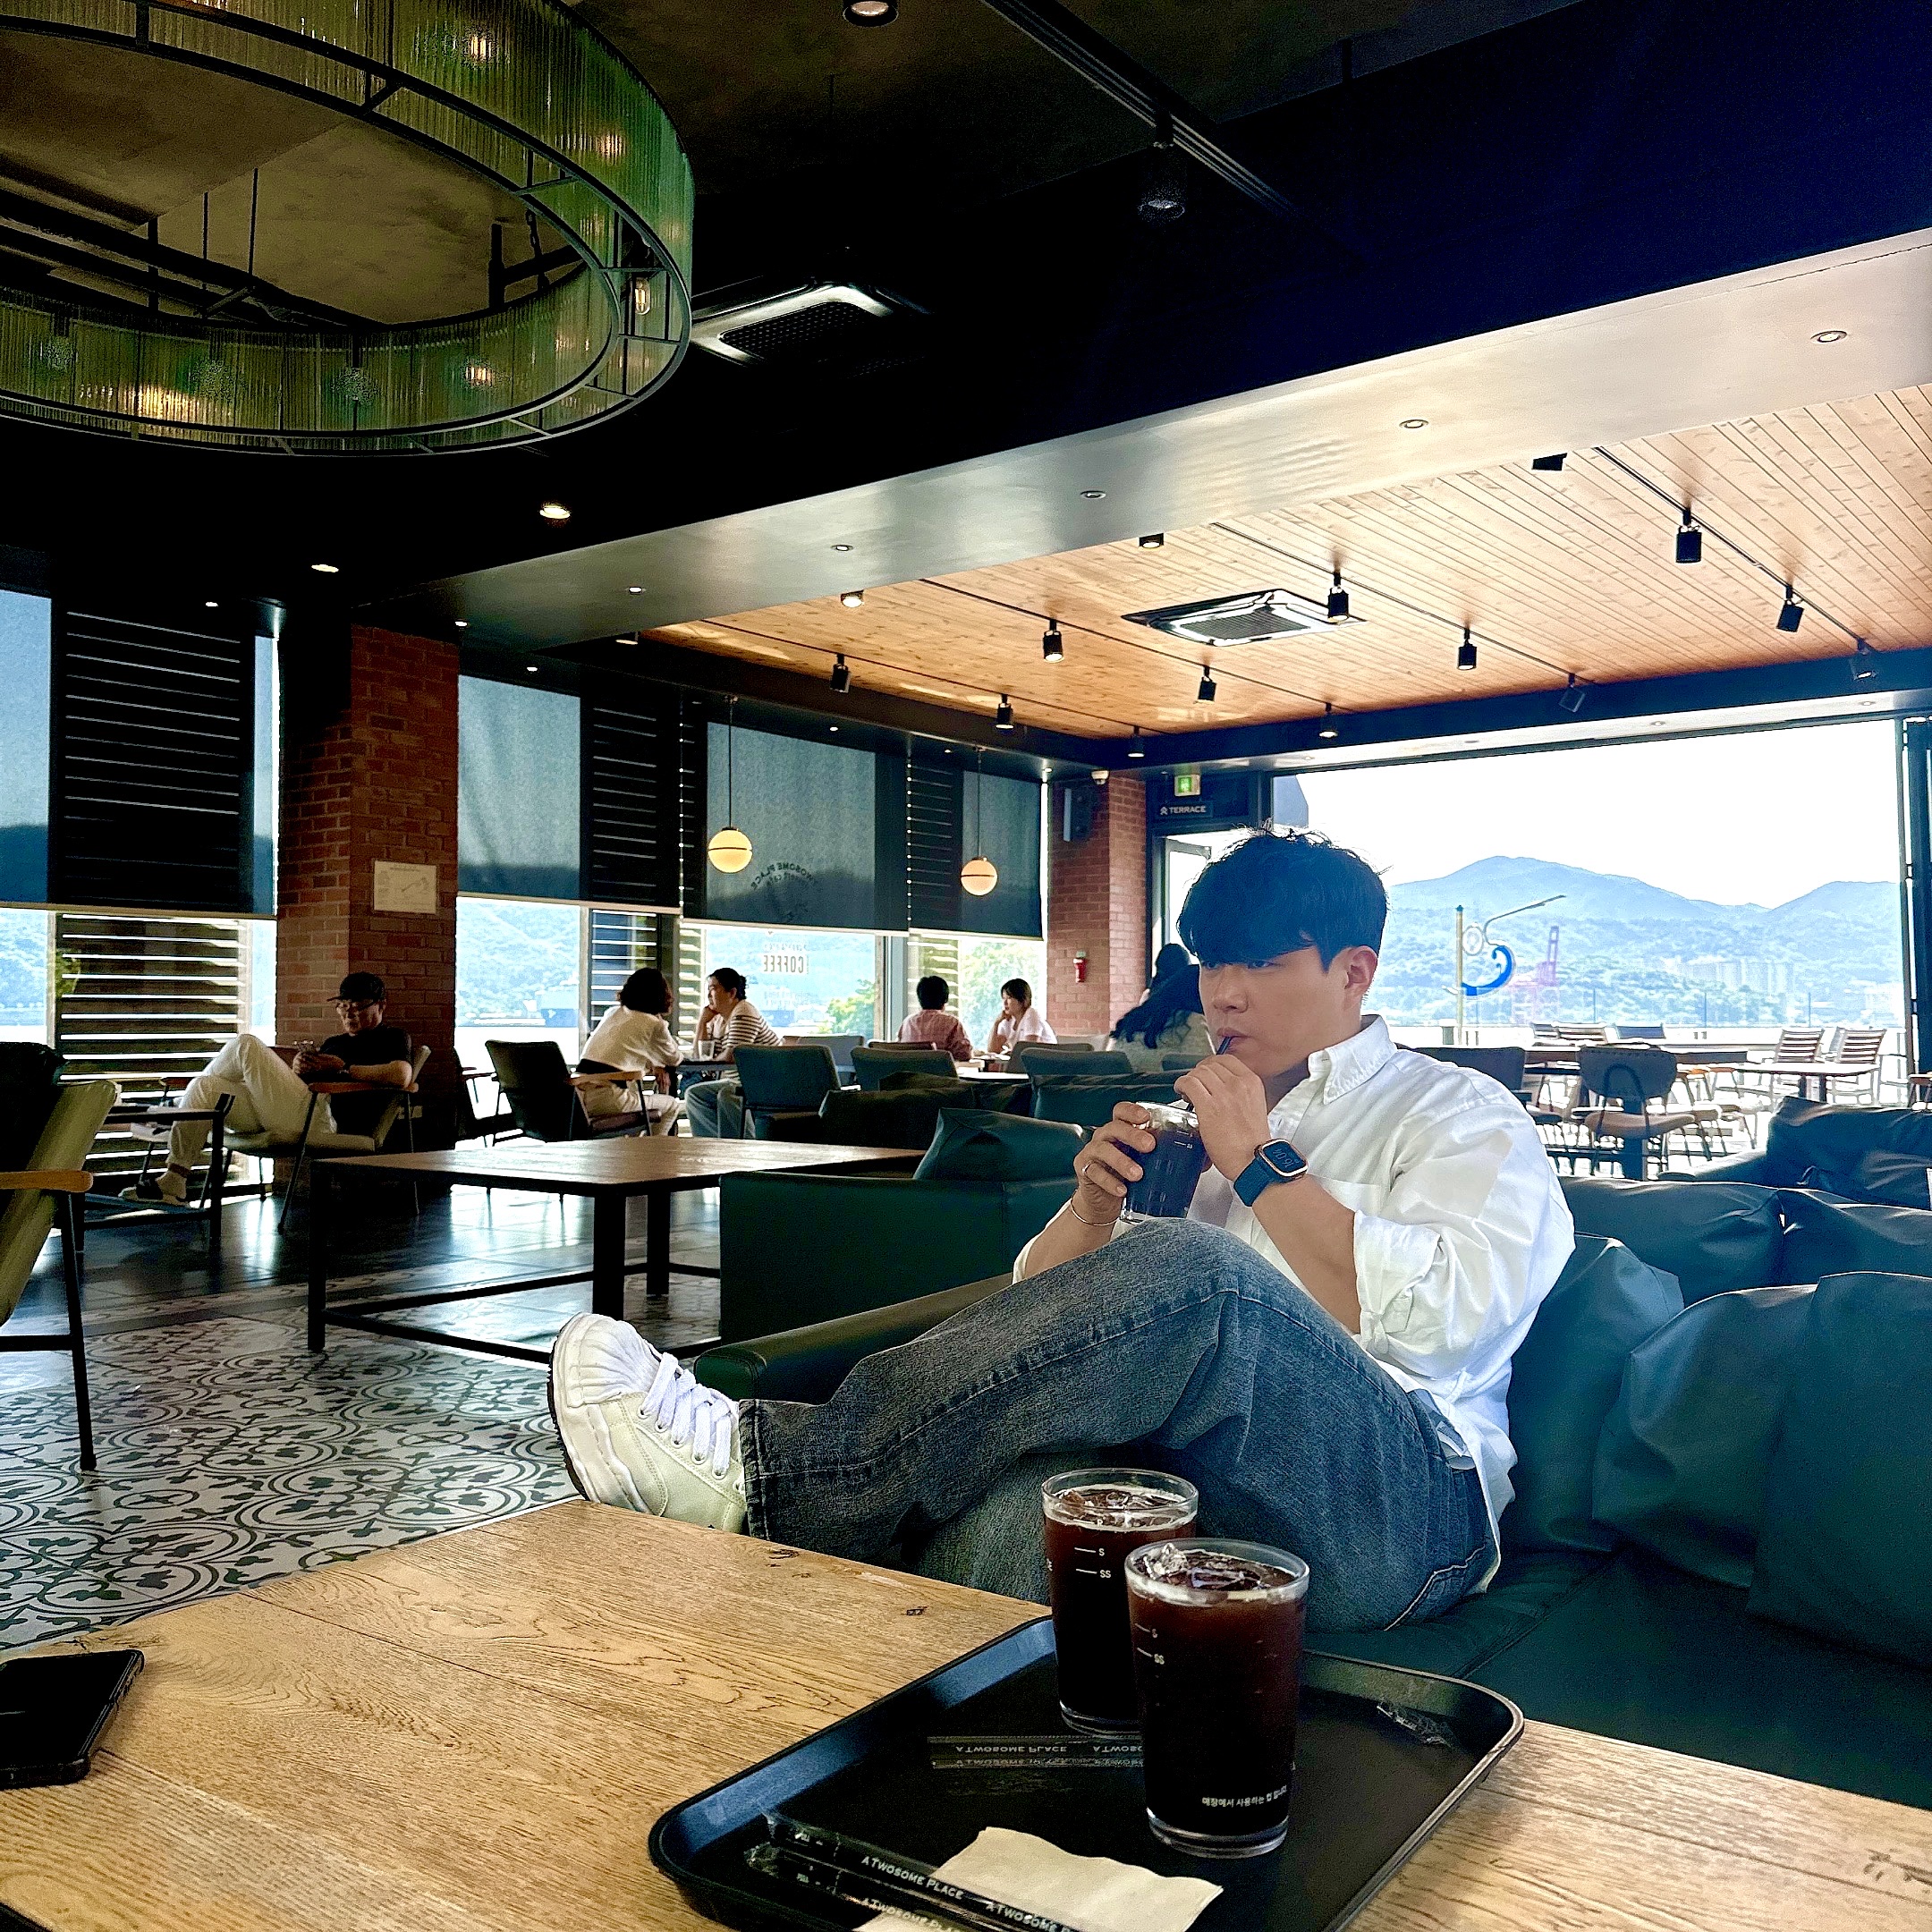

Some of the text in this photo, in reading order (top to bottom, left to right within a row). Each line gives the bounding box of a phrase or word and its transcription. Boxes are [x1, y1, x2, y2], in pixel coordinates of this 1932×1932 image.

[1169, 805, 1207, 814] TERRACE
[1098, 1547, 1106, 1556] S
[1099, 1569, 1112, 1579] SS
[1201, 1796, 1234, 1808] 매장에서
[871, 1857, 927, 1885] TWOSOME
[926, 1877, 964, 1900] PLACE
